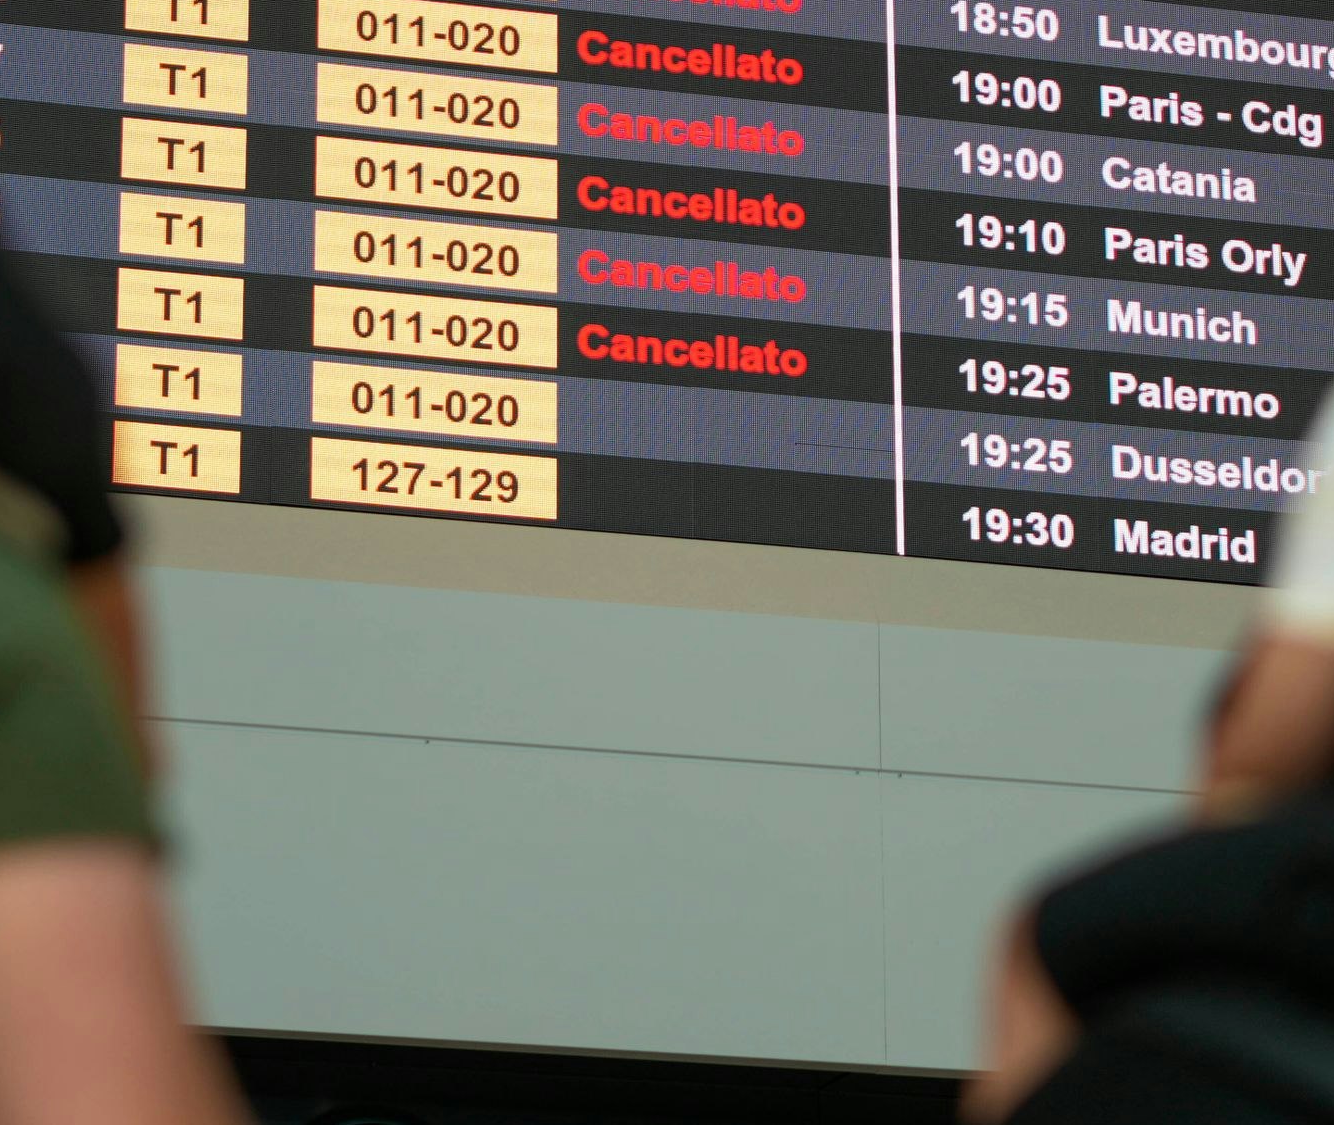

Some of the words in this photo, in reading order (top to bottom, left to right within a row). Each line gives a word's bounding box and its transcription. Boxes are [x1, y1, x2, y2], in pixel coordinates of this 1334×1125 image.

[354, 81, 522, 131] 011-020
[1099, 84, 1204, 128] Paris
[1241, 100, 1323, 149] Cdg
[576, 174, 807, 231] Cancellato
[1100, 155, 1257, 205] Catania
[955, 212, 1066, 256] 19:10
[1104, 226, 1210, 270] Paris
[1220, 238, 1307, 288] Orly
[1106, 297, 1258, 347] Munich
[576, 322, 809, 378] Cancellato
[1109, 370, 1280, 420] Palermo
[351, 457, 520, 505] 127-129
[961, 505, 1075, 549] 19:30
[1113, 517, 1256, 564] Madrid
